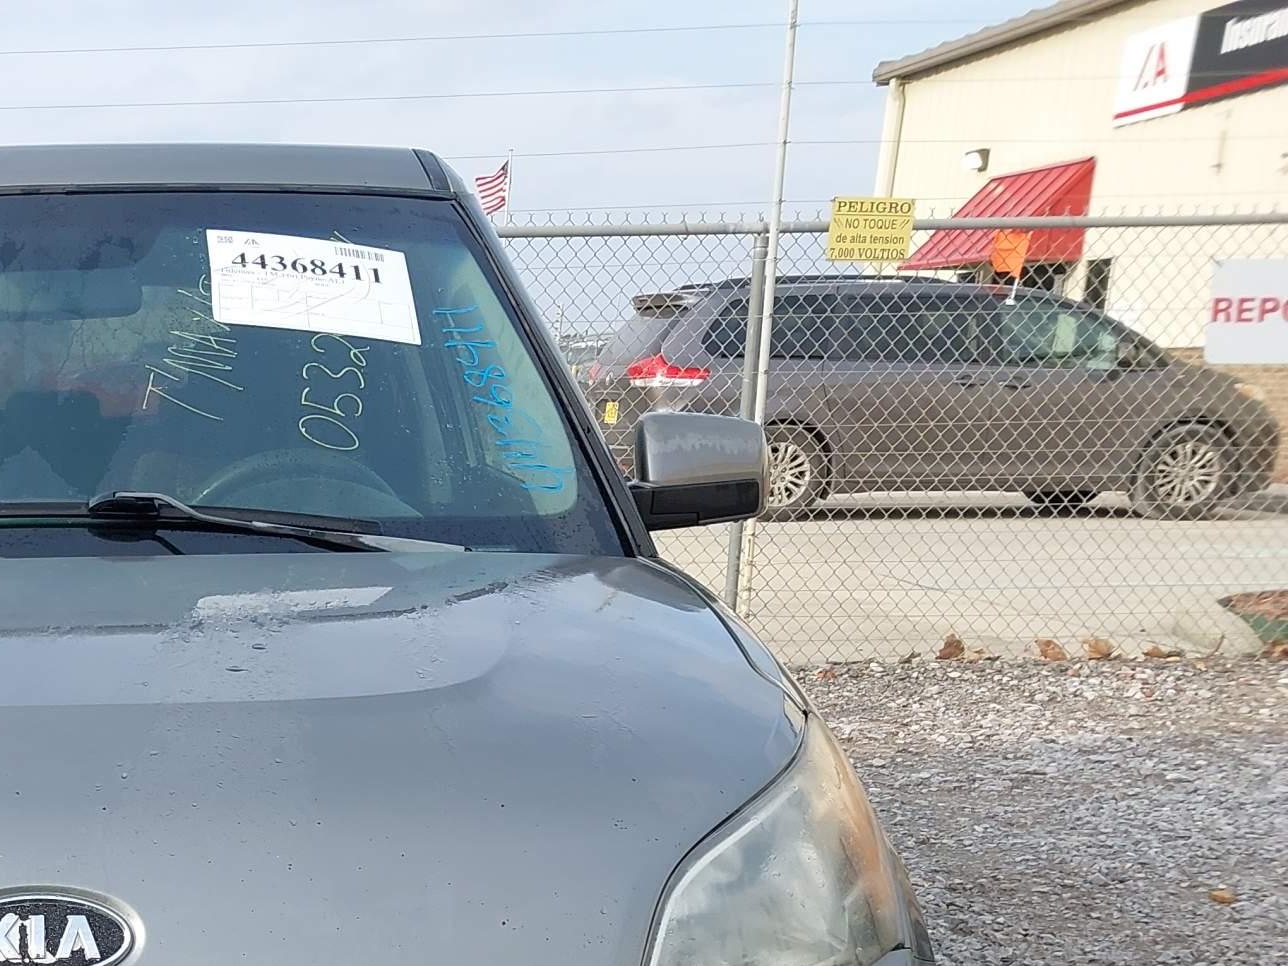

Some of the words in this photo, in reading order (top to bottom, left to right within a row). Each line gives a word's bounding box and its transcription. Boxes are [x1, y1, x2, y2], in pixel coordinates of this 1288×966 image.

[837, 200, 911, 214] PELIGRO
[845, 218, 860, 230] NO
[864, 218, 897, 230] TOQUE
[835, 233, 847, 243] de
[849, 233, 867, 244] alta
[870, 234, 904, 245] tension
[858, 247, 906, 260] VOLTIOS
[231, 252, 383, 285] 44368411
